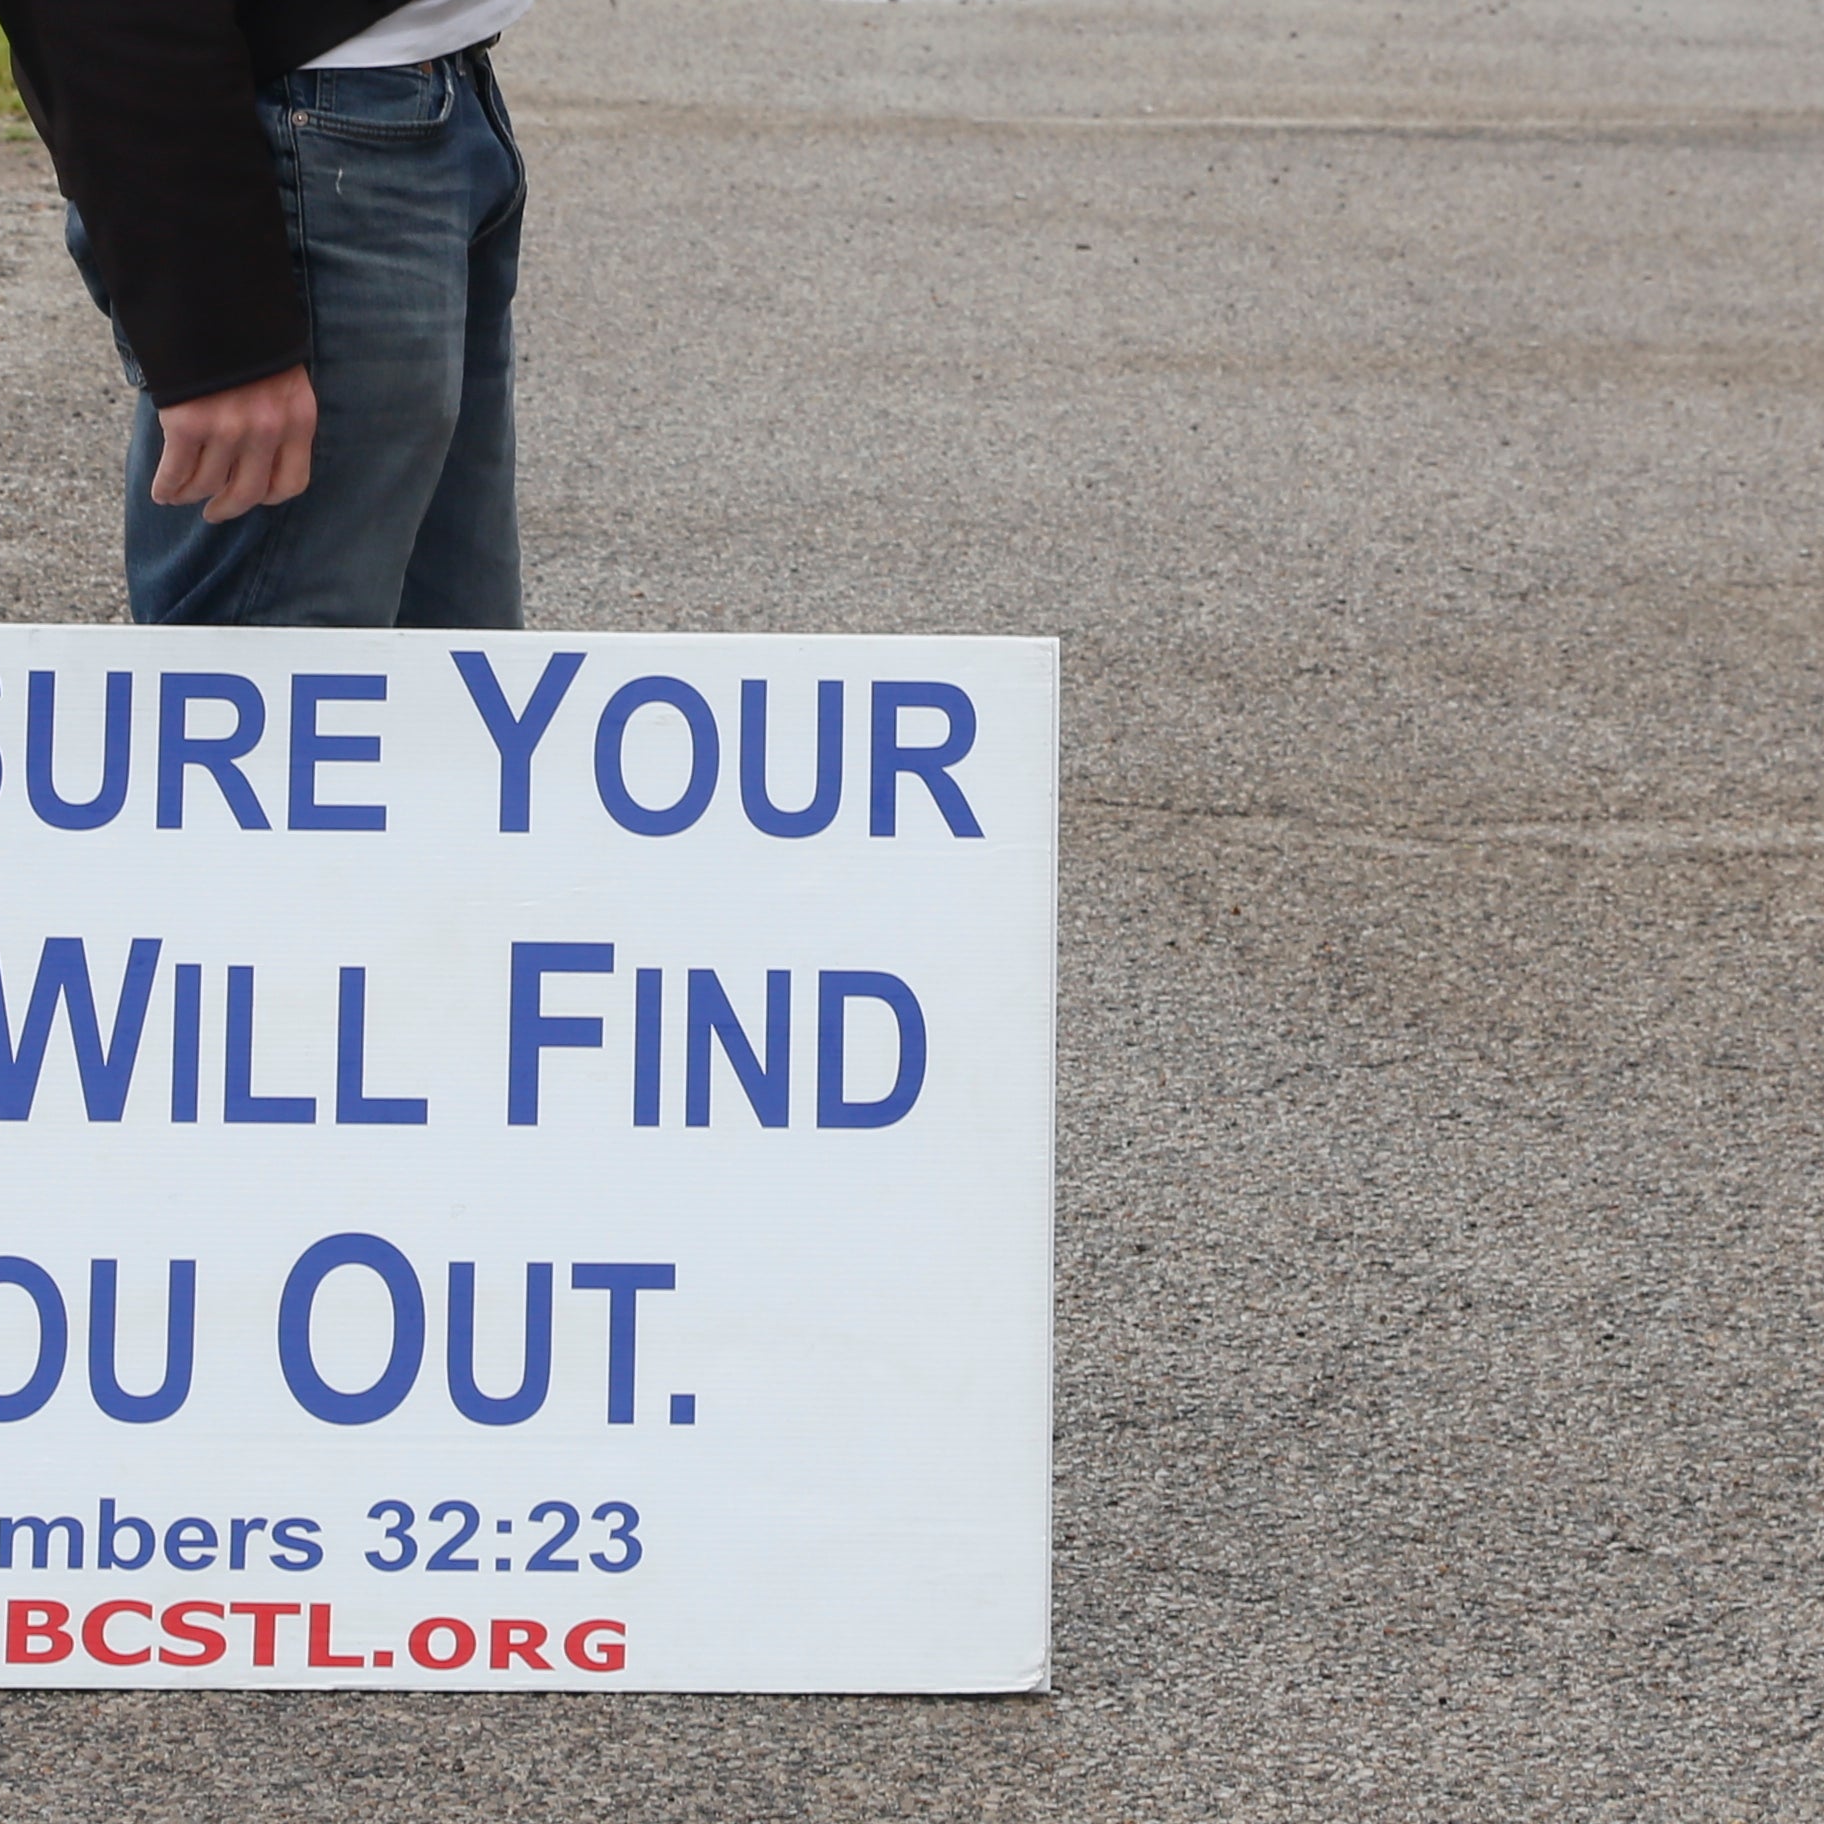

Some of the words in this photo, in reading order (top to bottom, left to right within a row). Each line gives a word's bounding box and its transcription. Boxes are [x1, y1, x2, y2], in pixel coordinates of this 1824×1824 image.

[452, 650, 984, 839] YOUR
[508, 941, 927, 1129] FIND
[278, 1232, 695, 1426] OUT.
[366, 1500, 642, 1573] 32:23
